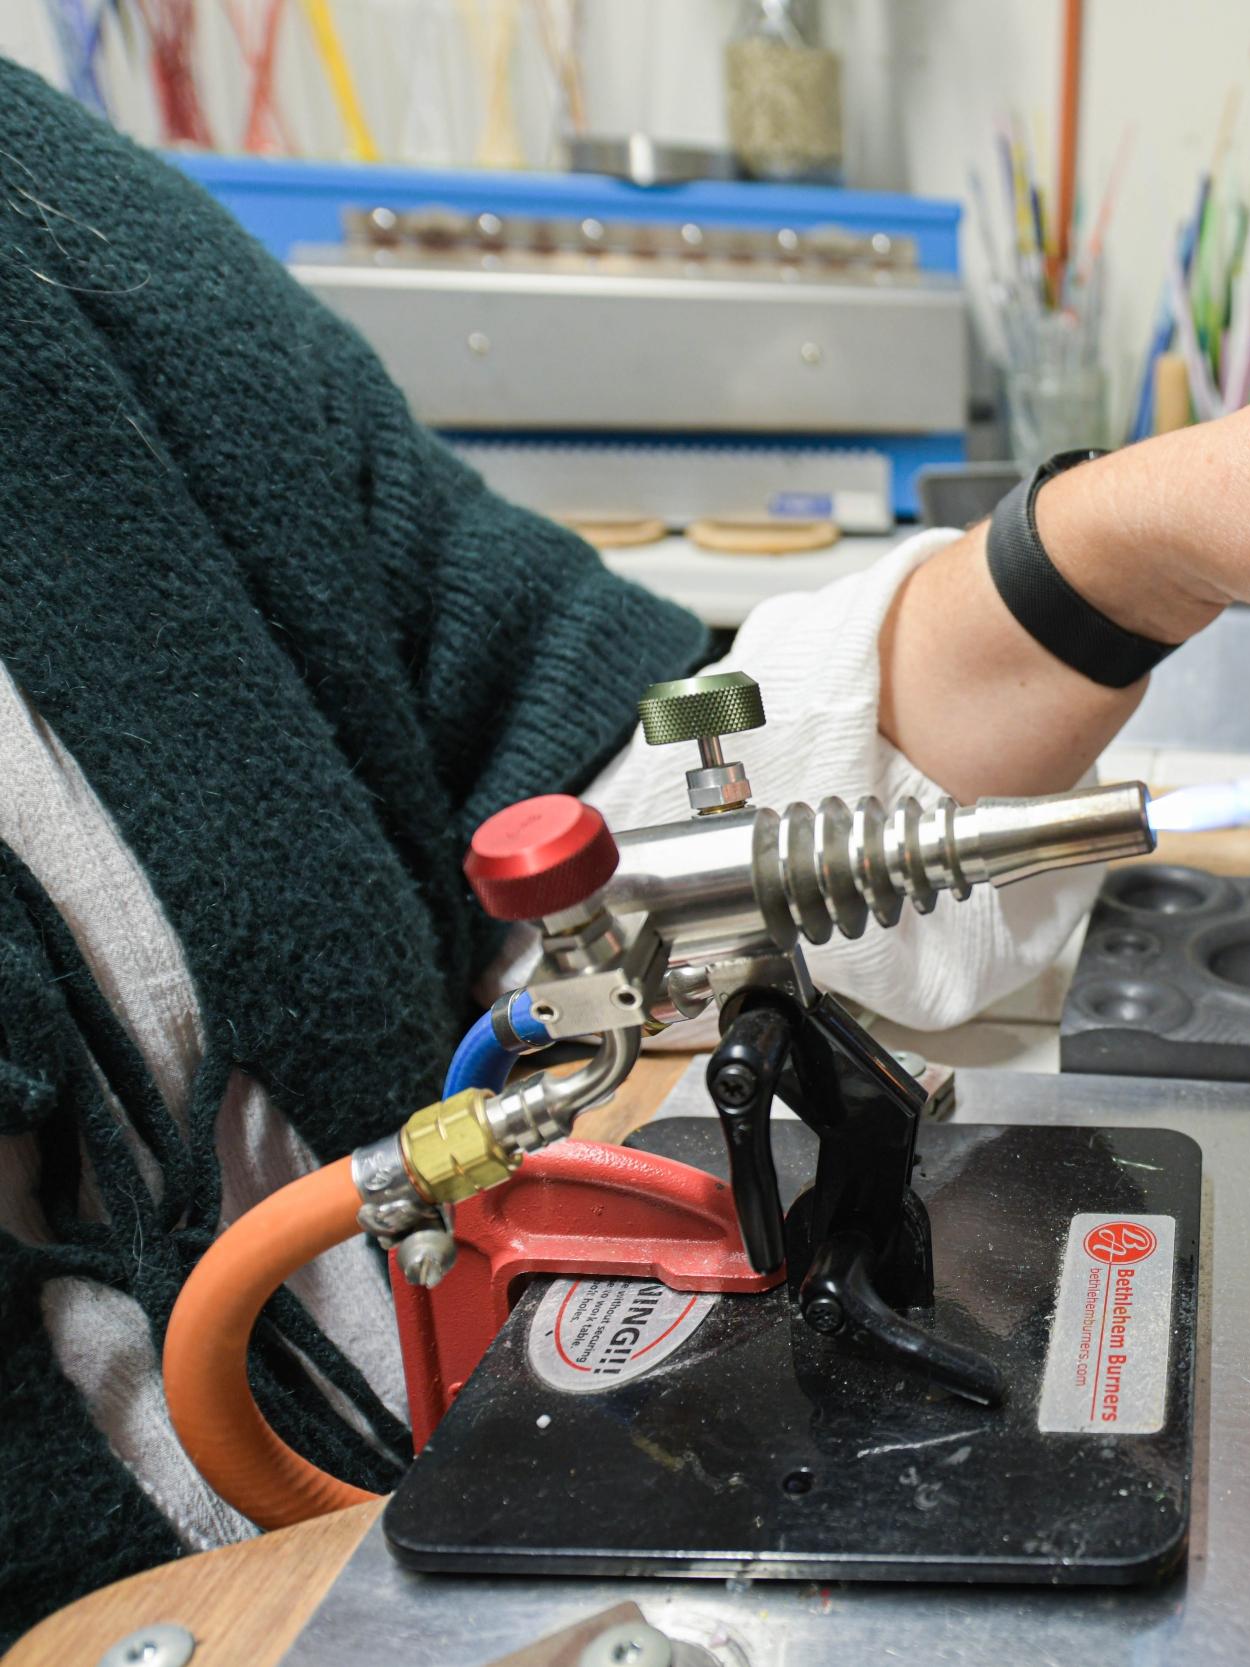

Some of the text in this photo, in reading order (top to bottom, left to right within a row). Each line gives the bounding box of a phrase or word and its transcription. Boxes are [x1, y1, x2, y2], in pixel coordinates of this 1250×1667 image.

[570, 1323, 592, 1349] table.
[576, 1290, 625, 1363] without securing
[586, 1300, 605, 1322] work
[1075, 1268, 1102, 1387] bethlehemburners.com
[1101, 1269, 1135, 1422] Bethlehem Burners
